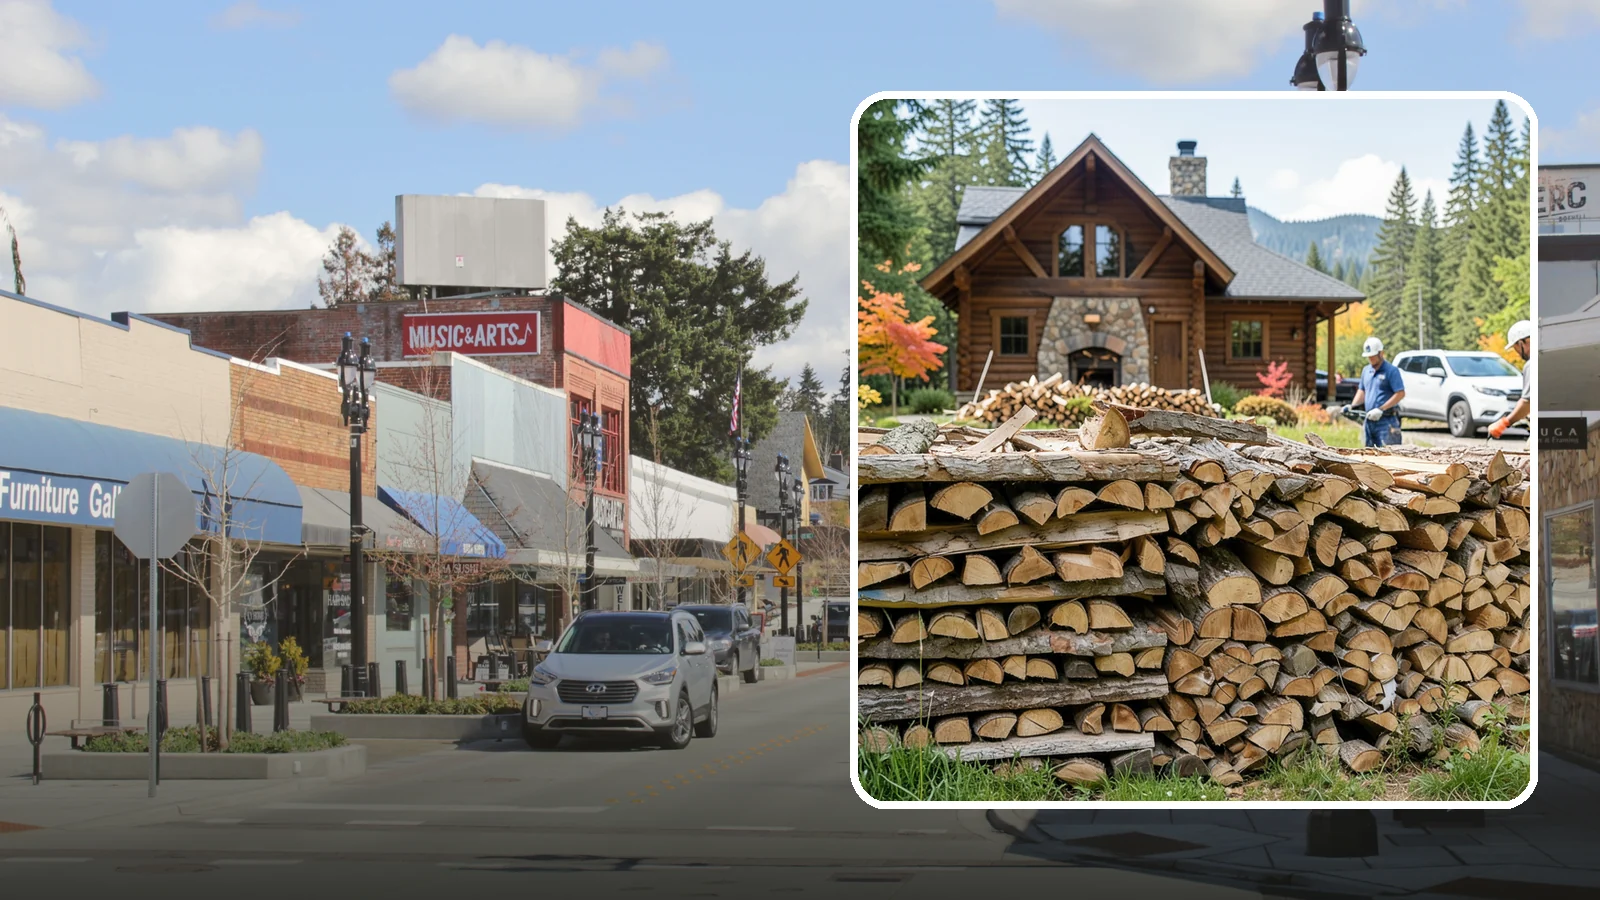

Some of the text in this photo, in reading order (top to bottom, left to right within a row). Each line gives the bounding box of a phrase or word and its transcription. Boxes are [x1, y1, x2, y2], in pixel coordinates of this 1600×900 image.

[408, 322, 520, 349] MUSIC&ARTS
[1540, 428, 1577, 436] UGA
[0, 471, 79, 515] Furniture
[453, 563, 479, 574] SUSHI
